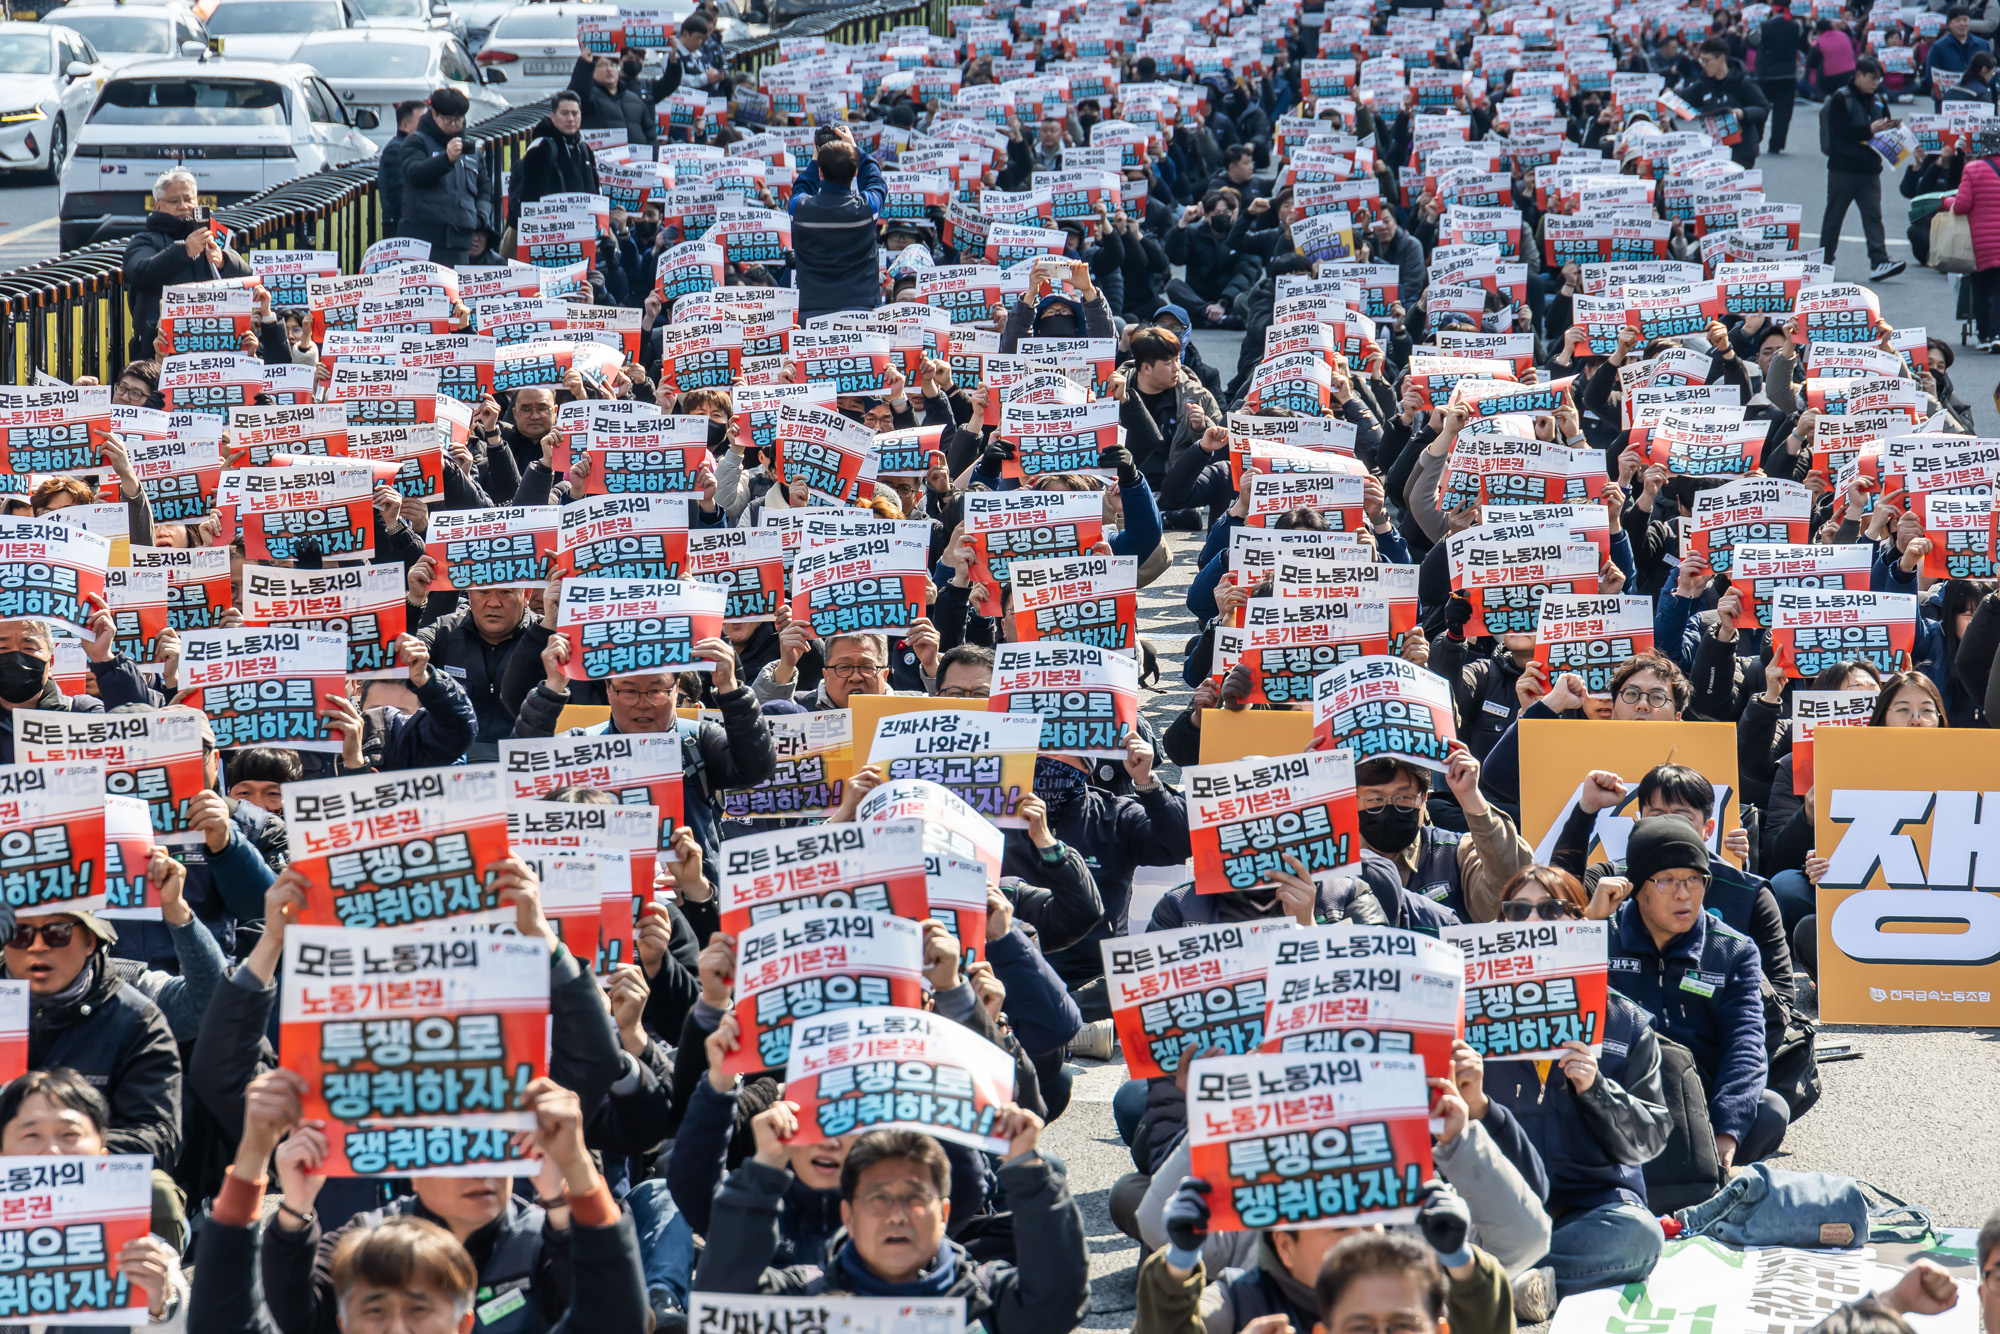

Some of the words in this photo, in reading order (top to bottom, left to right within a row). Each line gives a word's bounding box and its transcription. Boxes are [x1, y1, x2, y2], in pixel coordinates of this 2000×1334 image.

[166, 293, 186, 304] 모든
[188, 292, 227, 303] 노동자의
[1800, 288, 1819, 301] 모든
[1821, 286, 1861, 297] 노동자의
[1801, 299, 1850, 311] 노동기본권
[168, 305, 214, 317] 노동기본권
[1807, 311, 1868, 327] 투쟁으로
[173, 318, 234, 335] 투쟁으로
[1808, 328, 1877, 343] 쟁취하자!
[174, 336, 241, 352] 쟁취하자!
[26, 389, 79, 408] 노동자의
[1479, 396, 1561, 415] 쟁취하자!
[592, 420, 620, 433] 모든
[624, 417, 675, 432] 노동자의
[1006, 407, 1035, 421] 모든
[1037, 406, 1087, 419] 노동자의
[1010, 421, 1073, 434] 노동기본권
[1663, 417, 1692, 432] 모든
[1692, 423, 1740, 434] 노동자의
[8, 423, 89, 449] 투쟁으로
[595, 434, 660, 448] 노동기본권
[1020, 432, 1097, 454] 투쟁으로
[1664, 429, 1723, 445] 노동기본권
[604, 449, 685, 471] 투쟁으로
[1021, 452, 1100, 473] 쟁취하자
[1669, 442, 1743, 459] 투쟁으로
[1669, 456, 1752, 475] 쟁취하자!
[246, 474, 278, 493] 모든
[280, 470, 336, 490] 노동자의
[604, 471, 695, 493] 쟁취하자!
[250, 490, 319, 511] 노동기본권
[969, 498, 1002, 513] 모든
[1005, 494, 1065, 511] 노동자의
[0, 520, 69, 542] 노동자의
[263, 505, 350, 535] 투쟁으로
[433, 515, 464, 527] 모든
[467, 508, 525, 524] 노동자의
[973, 510, 1047, 531] 노동기본권
[436, 523, 507, 541] 노동기본권
[986, 524, 1078, 555] 투쟁으로
[446, 534, 536, 563] 투쟁으로
[797, 555, 827, 575] 모든
[829, 538, 890, 563] 노동자의
[0, 564, 78, 594] 쟁으로
[448, 557, 548, 588] 쟁취하자!
[801, 559, 872, 591] 노동기본권
[1017, 569, 1048, 588] 모든
[1049, 559, 1108, 582] 노동자의
[0, 590, 89, 620] 취하자!
[567, 586, 605, 604] 모든
[610, 583, 681, 601] 노동자의
[810, 577, 904, 610] 투쟁으로
[1023, 580, 1093, 608] 노동기본권
[1779, 594, 1812, 609] 모든
[1815, 594, 1877, 607] 노동자의
[570, 601, 658, 623] 노동기본권
[810, 602, 918, 638] 쟁취하자!
[1035, 599, 1118, 632] 투쟁으로
[1249, 606, 1280, 626] 모든
[1283, 602, 1349, 623] 노동자의
[1542, 602, 1564, 620] 모든
[1566, 598, 1621, 618] 노동자의
[1783, 609, 1859, 625] 노동기본권
[582, 617, 691, 649] 투쟁으로
[1250, 624, 1329, 647] 노동기본권
[1543, 619, 1603, 641] 노동기본권
[1793, 626, 1889, 650] 투쟁으로
[185, 641, 224, 661] 모든
[227, 633, 300, 656] 노동자의
[583, 641, 695, 679] 쟁취하자
[999, 652, 1032, 671] 모든
[1035, 648, 1103, 668] 노동자의
[1549, 638, 1633, 664] 투쟁으로
[190, 656, 278, 685] 노동기본권
[1000, 669, 1081, 692] 노동기본권
[1318, 676, 1348, 701] 모든
[1350, 661, 1416, 684] 노동자의
[203, 679, 315, 714] 투쟁으로
[1009, 692, 1114, 719] 투쟁으로
[1322, 680, 1400, 719] 노동기본권
[880, 715, 960, 739] 진짜사장
[1333, 700, 1434, 737] 투쟁으로
[915, 730, 990, 754] 나와라!
[1040, 722, 1129, 749] 취하자!
[507, 750, 551, 774] 모든
[554, 738, 633, 769] 노동자의
[889, 756, 1000, 785] 원청교섭
[1192, 775, 1232, 799] 모든
[1234, 758, 1310, 791] 노동자의
[296, 794, 348, 823] 모든
[351, 773, 447, 813] 노동자의
[725, 786, 842, 816] 쟁취하자!
[1199, 787, 1292, 824] 노동기본권
[304, 806, 423, 853] 노동기본권
[1218, 804, 1333, 855] 투쟁으로
[328, 831, 473, 889] 투쟁으로
[727, 850, 770, 876] 모든
[776, 826, 866, 864] 노동자의
[733, 859, 841, 904] 노동기본권
[742, 935, 778, 966] 모든
[783, 914, 875, 943] 노동자의
[1112, 947, 1155, 975] 모든
[1158, 926, 1244, 963] 노동자의
[1479, 926, 1558, 955] 노동자의
[296, 942, 355, 979] 모든
[362, 936, 479, 975] 노동자의
[744, 945, 849, 989] 노동기본권
[1120, 959, 1222, 1003] 노동기본권
[302, 978, 444, 1016] 노동기본권
[1140, 979, 1267, 1036] 투쟁으로
[320, 1015, 503, 1068] 투쟁으로
[798, 1018, 851, 1051] 모든
[858, 1014, 932, 1037] 노동자
[803, 1038, 927, 1071] 노동기본권
[323, 1065, 534, 1119] 쟁취하자!
[816, 1060, 975, 1100] 투쟁으로
[1197, 1072, 1245, 1102] 모든
[1257, 1059, 1363, 1094] 노동자의
[818, 1095, 995, 1138] 쟁취하자!
[1205, 1093, 1335, 1136] 노동기본권
[1227, 1122, 1393, 1180] 투쟁으로
[1232, 1163, 1419, 1228] 쟁취하자!
